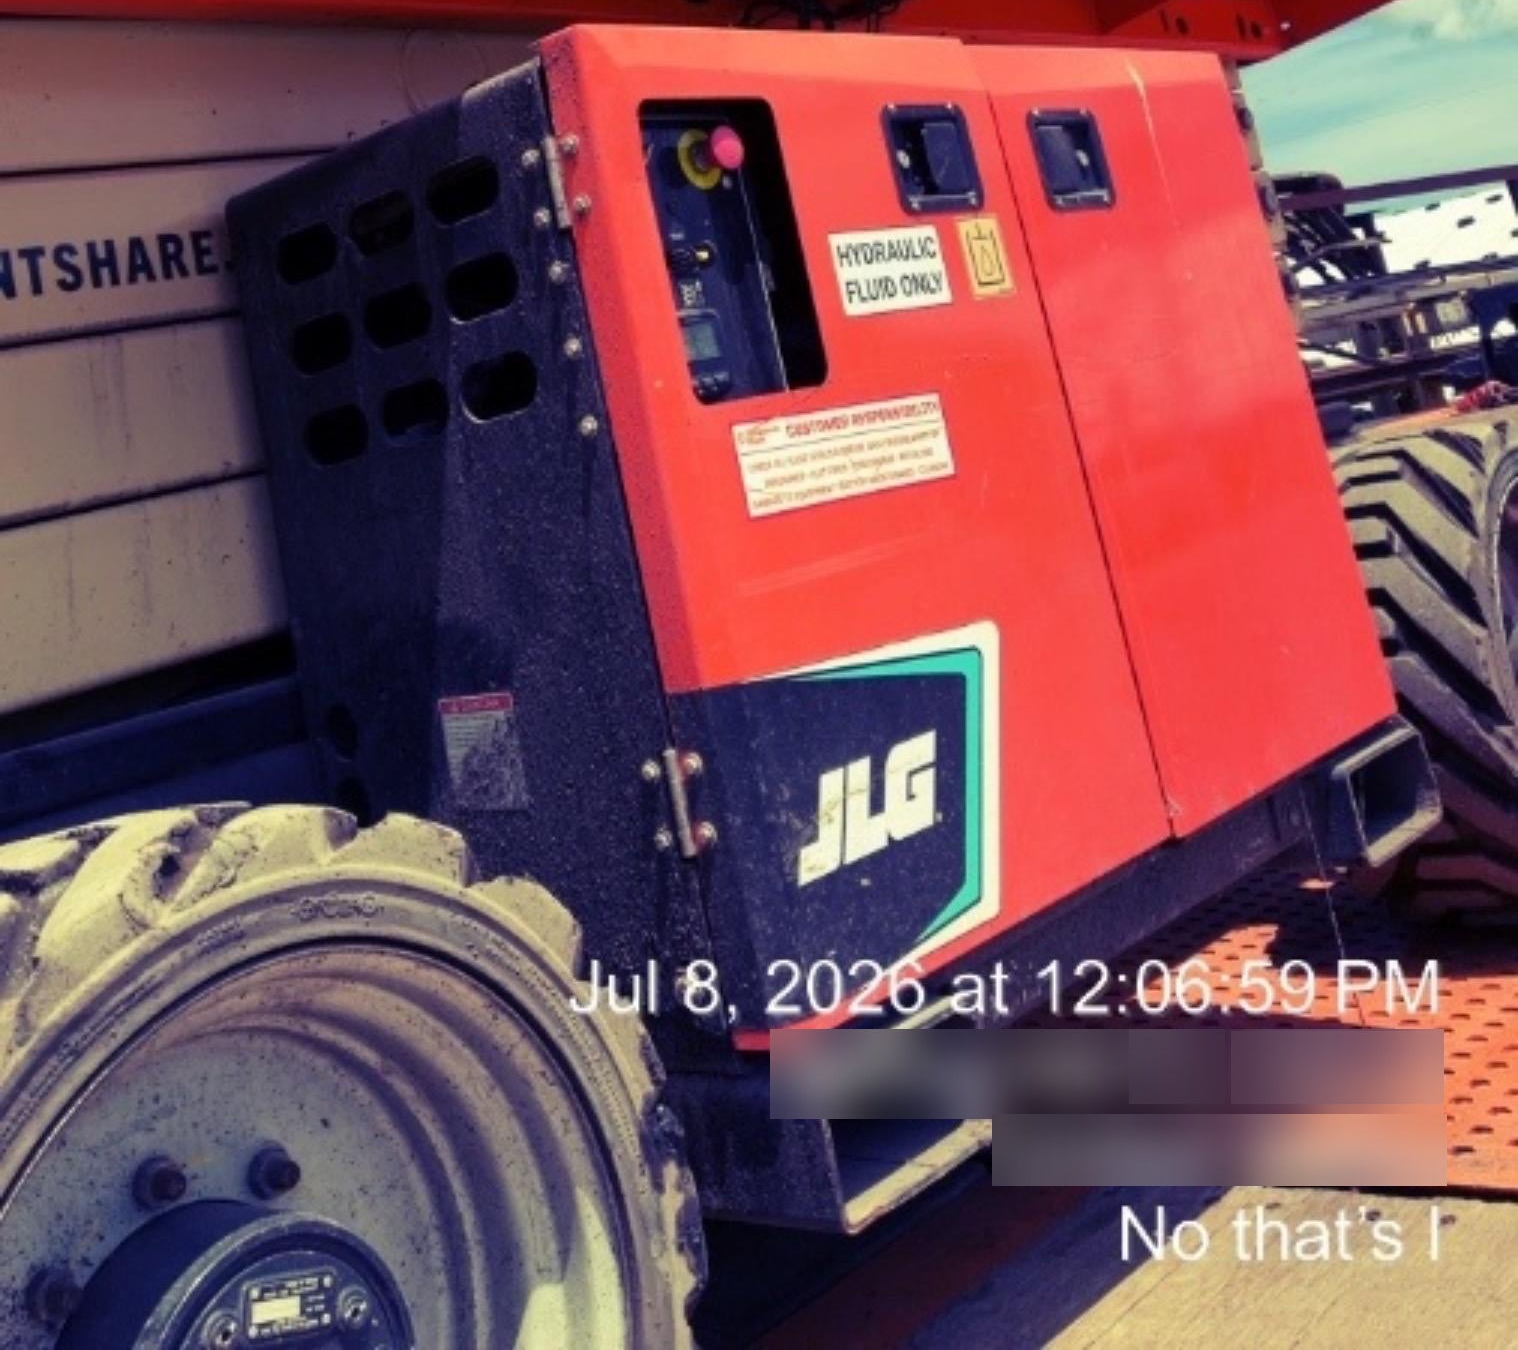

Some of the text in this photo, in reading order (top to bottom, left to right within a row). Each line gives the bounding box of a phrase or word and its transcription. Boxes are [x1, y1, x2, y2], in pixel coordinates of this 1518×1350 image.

[836, 236, 937, 267] HYDRAULIC
[845, 271, 942, 304] FLUID ONLY
[798, 729, 937, 887] JLG
